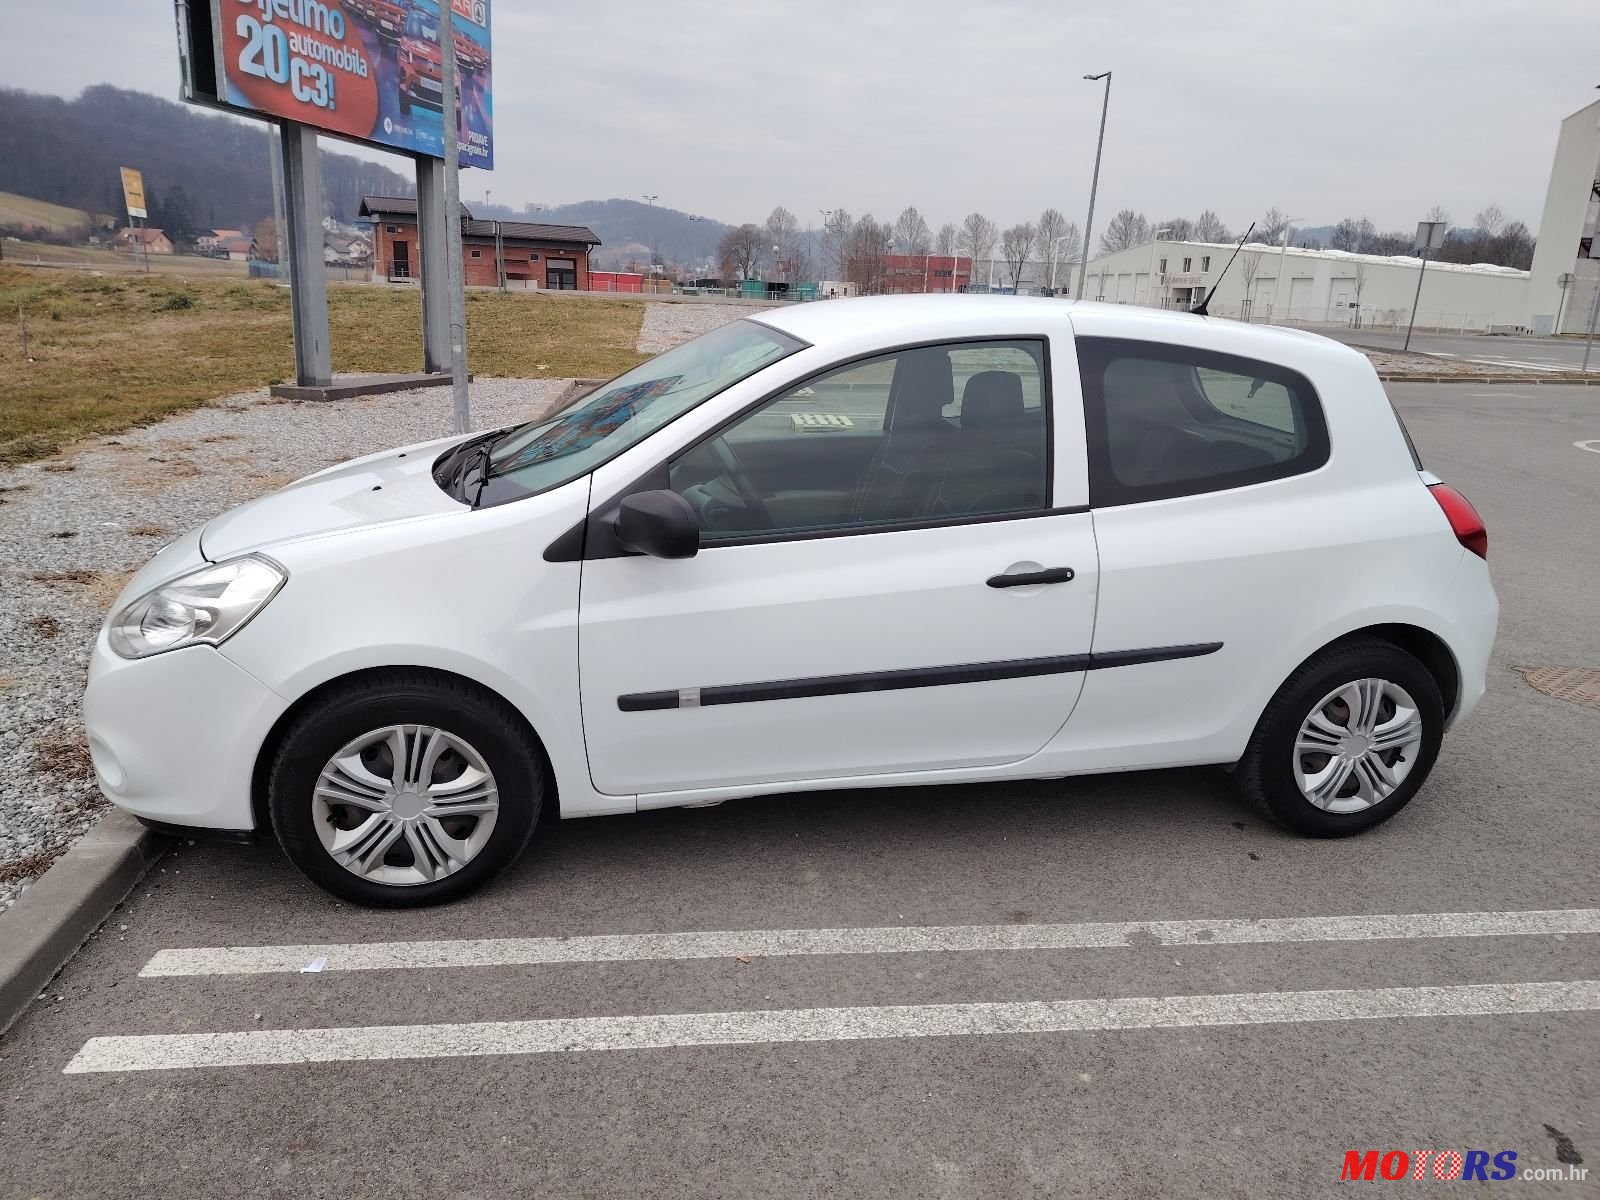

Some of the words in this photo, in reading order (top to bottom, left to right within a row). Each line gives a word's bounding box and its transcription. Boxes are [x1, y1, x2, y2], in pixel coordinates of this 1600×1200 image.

[236, 14, 289, 84] 20
[289, 31, 368, 78] automobila
[290, 57, 336, 111] C3!
